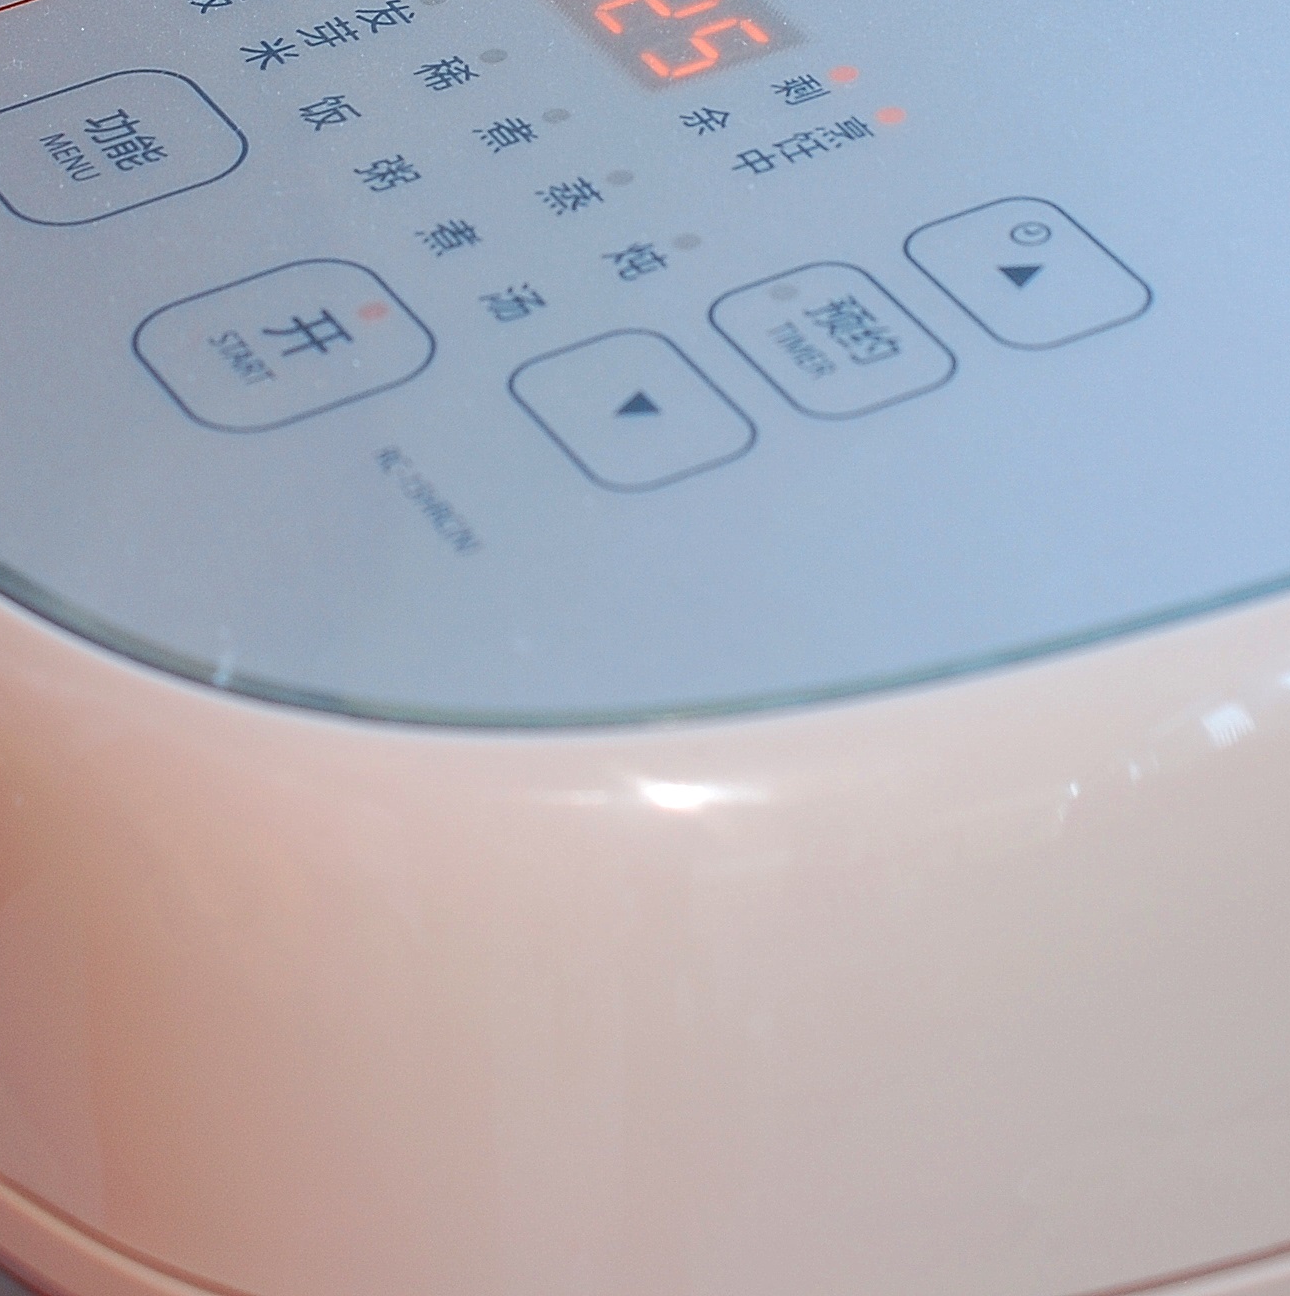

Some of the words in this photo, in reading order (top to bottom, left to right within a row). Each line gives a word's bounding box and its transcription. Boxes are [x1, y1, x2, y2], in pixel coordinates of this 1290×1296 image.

[241, 0, 415, 71] 发芽米
[39, 133, 101, 181] MENU
[85, 109, 168, 171] 功能
[208, 330, 276, 385] START
[262, 308, 354, 355] 开
[768, 321, 836, 379] TIMER
[804, 295, 900, 365] 预约
